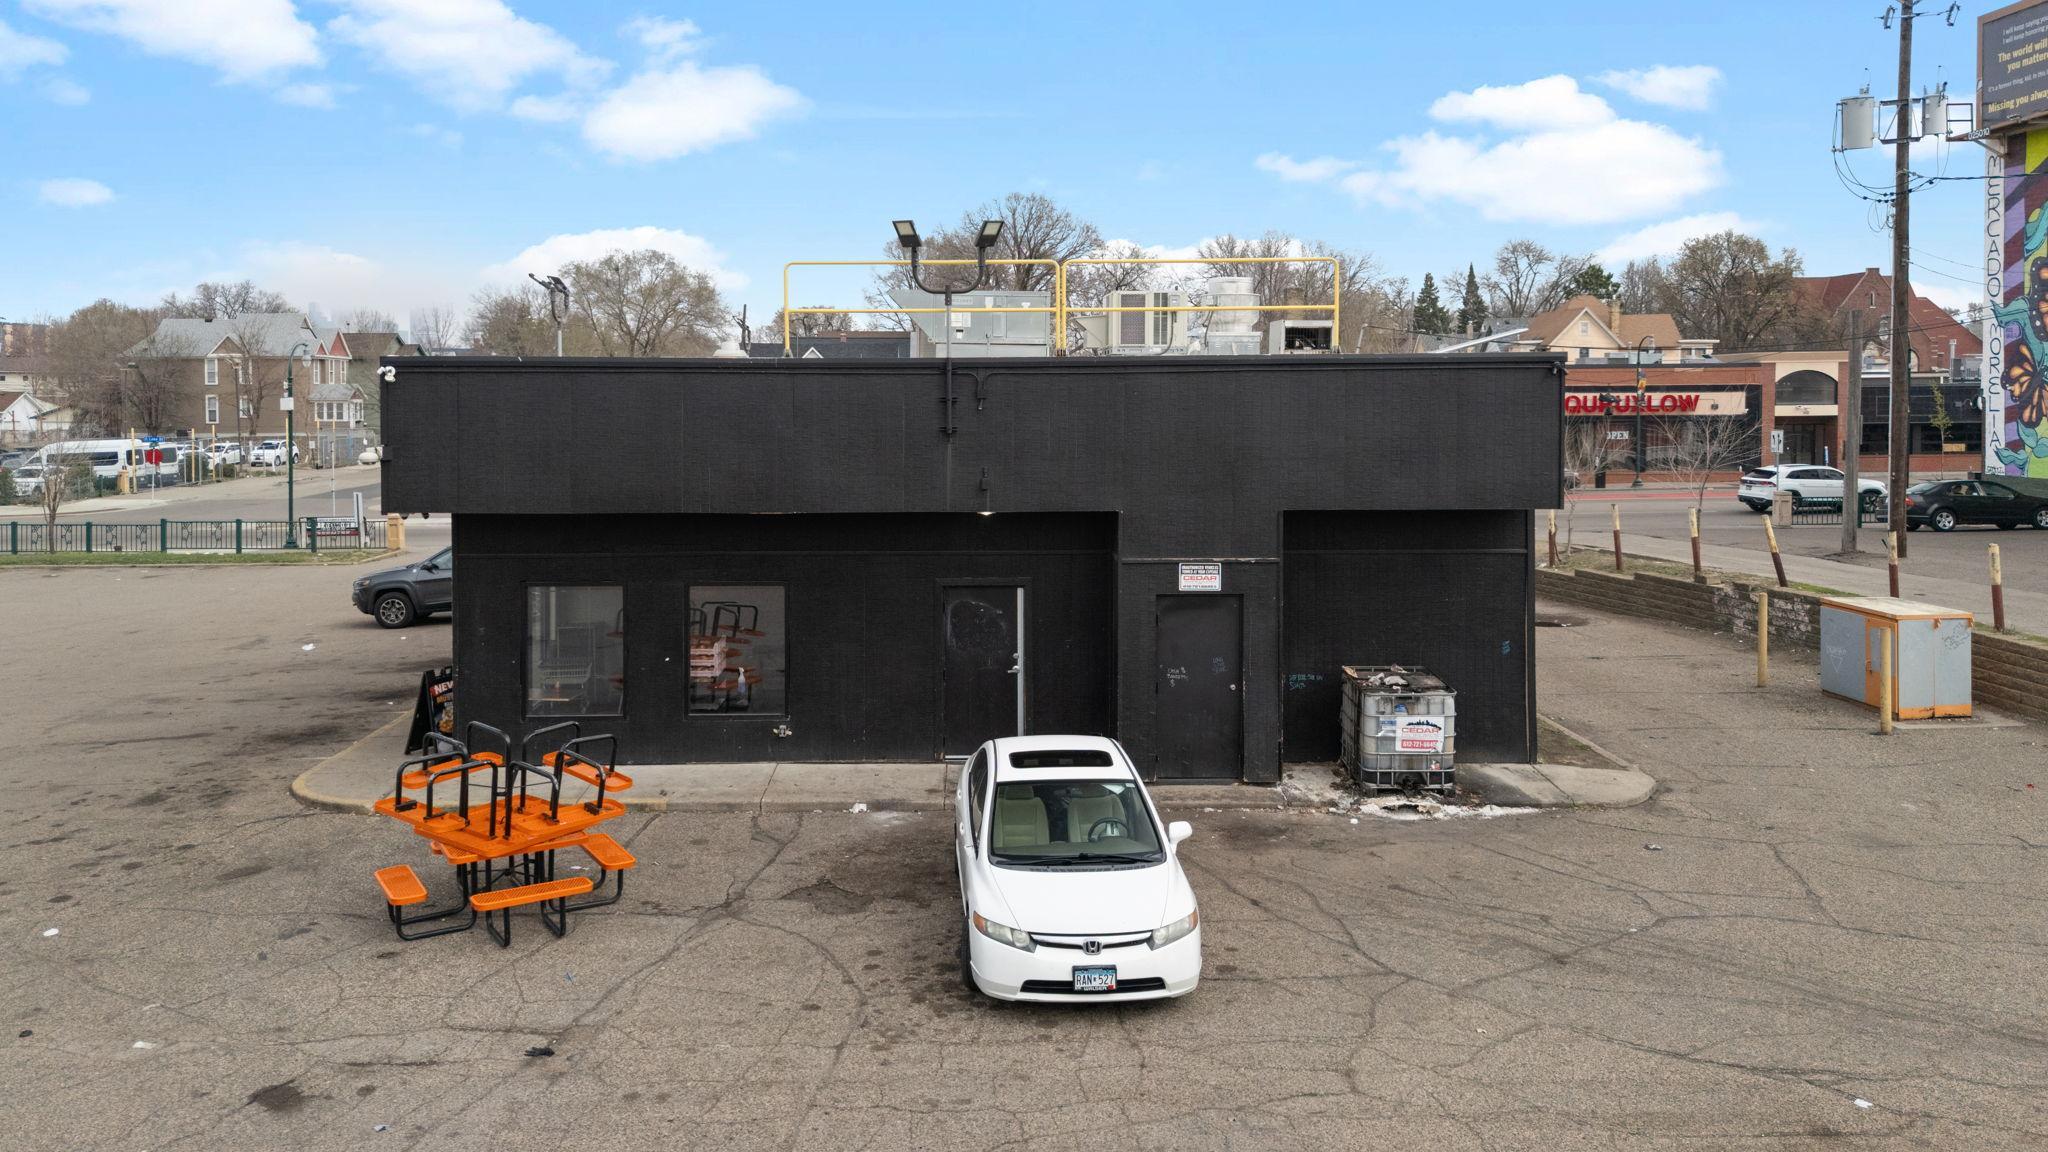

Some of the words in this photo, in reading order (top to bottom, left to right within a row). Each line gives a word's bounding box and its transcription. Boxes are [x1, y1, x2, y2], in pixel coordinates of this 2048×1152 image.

[1998, 52, 2010, 62] The
[2012, 42, 2032, 57] world
[2034, 37, 2048, 50] will
[2007, 60, 2021, 73] you
[1988, 99, 2015, 113] Missing
[2015, 95, 2029, 108] you
[1986, 154, 2001, 297] MERCADO
[1988, 322, 2001, 447] MORELIA
